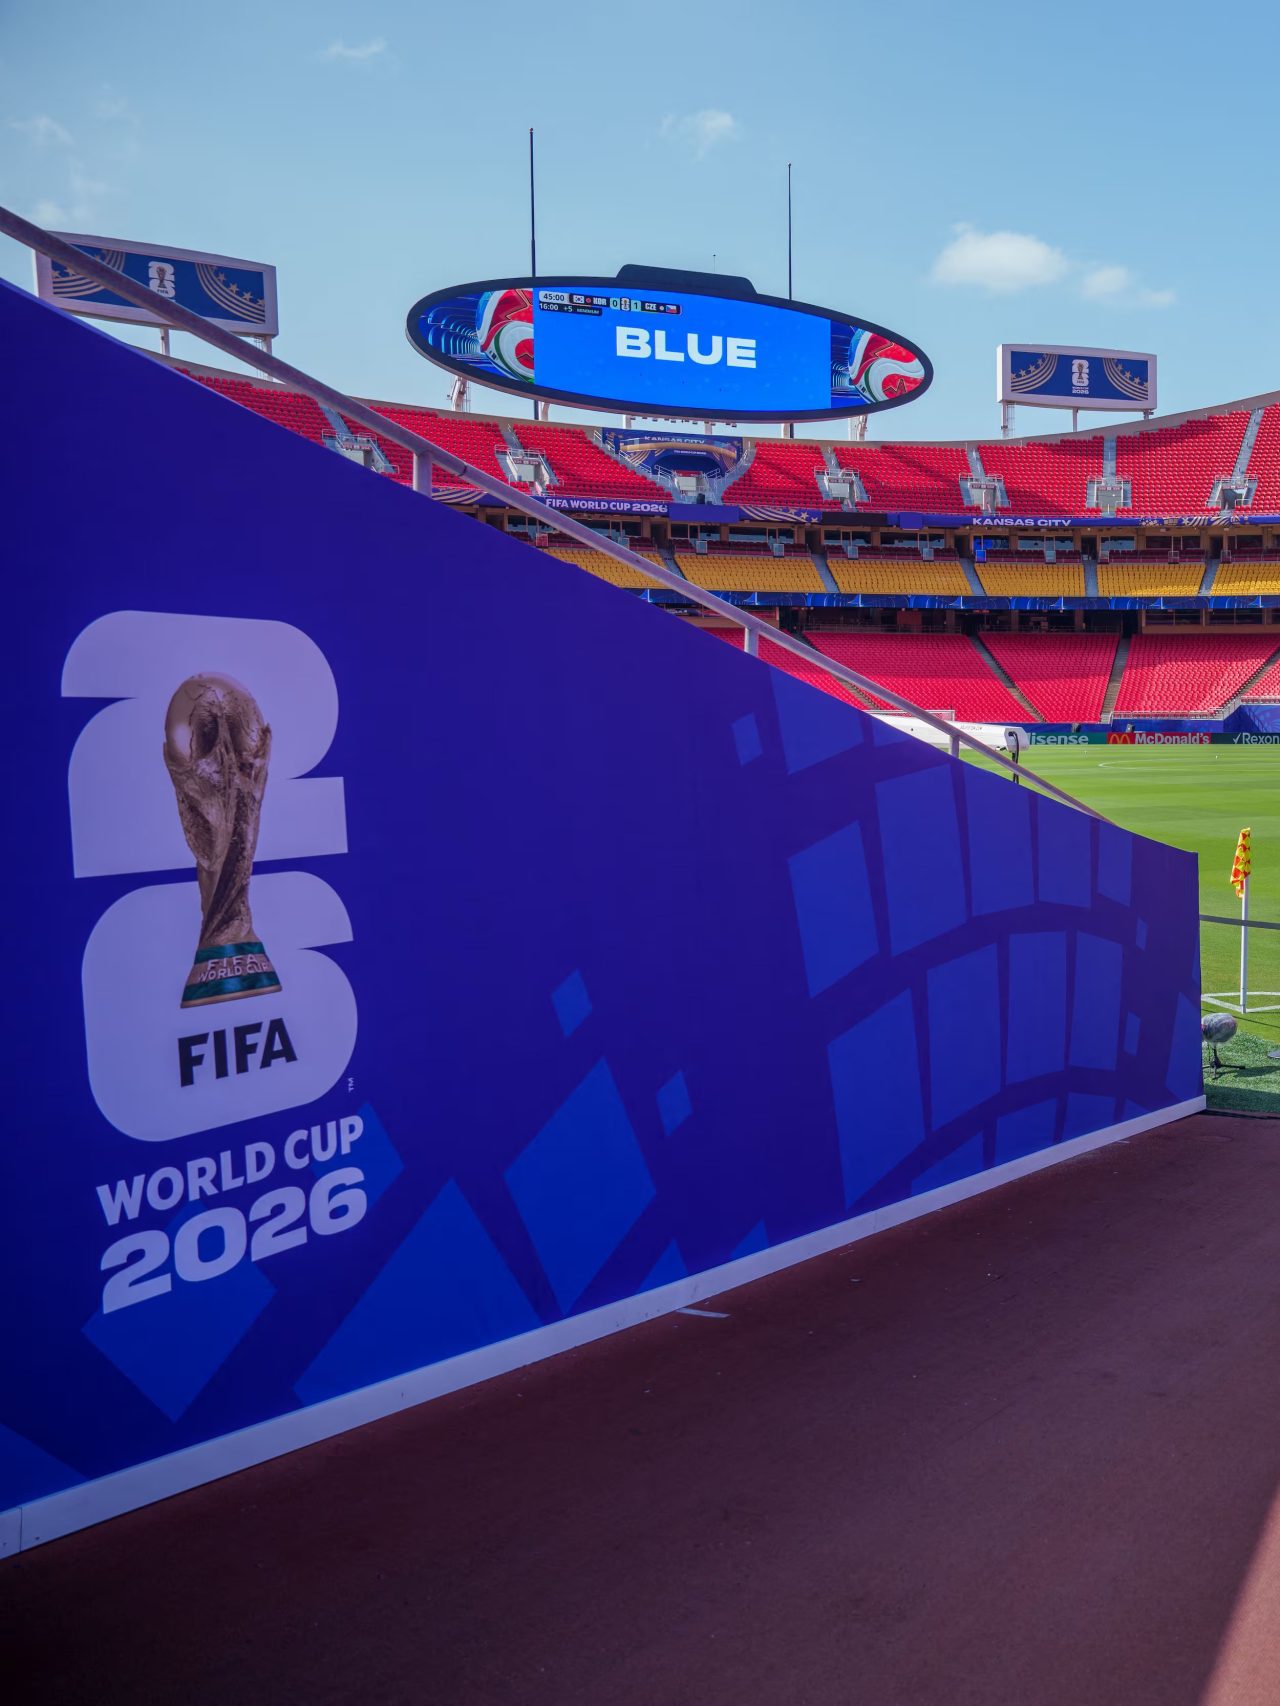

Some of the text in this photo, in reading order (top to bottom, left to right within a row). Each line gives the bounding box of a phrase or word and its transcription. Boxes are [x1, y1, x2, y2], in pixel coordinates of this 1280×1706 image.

[543, 292, 565, 302] 45:00
[592, 296, 607, 305] KOR
[612, 299, 618, 308] 0
[644, 302, 657, 311] CZE
[540, 303, 559, 311] 16:00
[616, 326, 756, 368] BLUE
[545, 498, 668, 513] FIFA WORLD CUP 2026
[972, 517, 1072, 527] KANSAS CITY
[1134, 732, 1210, 745] McDonald's
[207, 953, 258, 971] FIFA
[198, 961, 269, 983] WORLD CUP
[176, 1016, 299, 1088] FIFA
[95, 1114, 364, 1228] WORLD CUP
[99, 1166, 369, 1316] 2026
